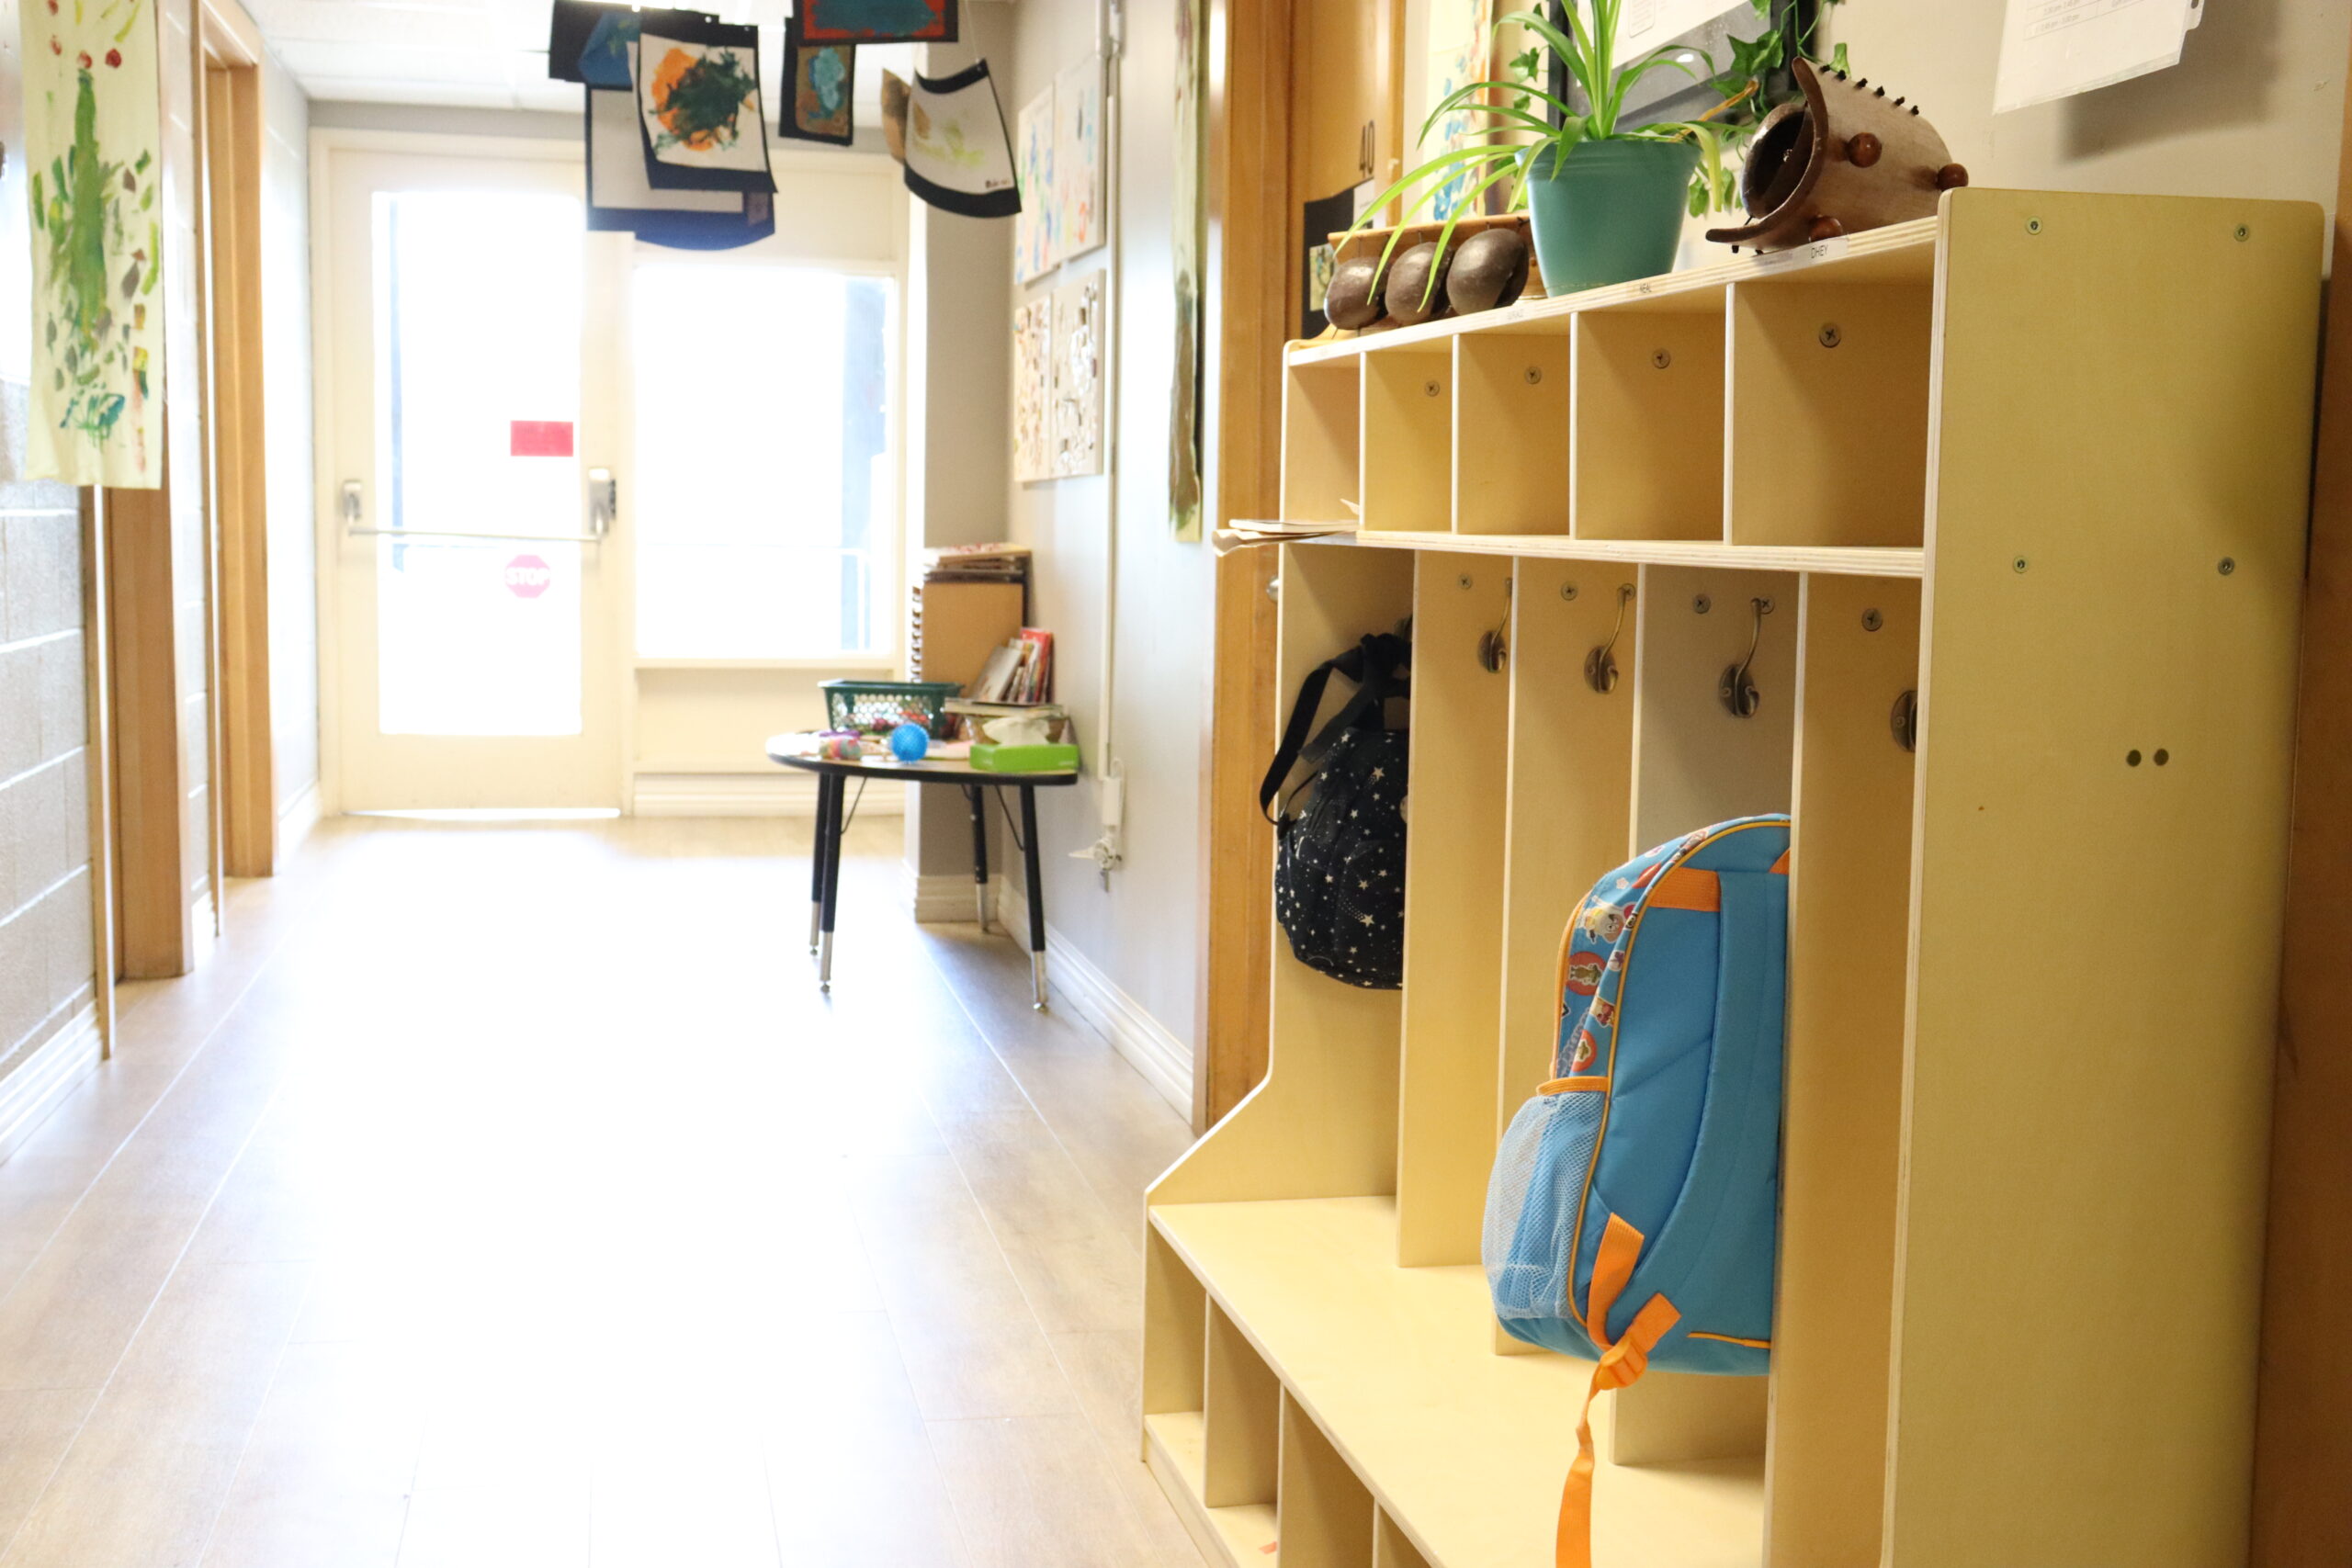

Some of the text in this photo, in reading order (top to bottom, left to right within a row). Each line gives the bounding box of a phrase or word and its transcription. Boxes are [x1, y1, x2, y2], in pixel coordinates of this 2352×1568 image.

[1359, 119, 1375, 179] 40
[1810, 243, 1829, 259] DHEY
[505, 567, 551, 586] STOP
